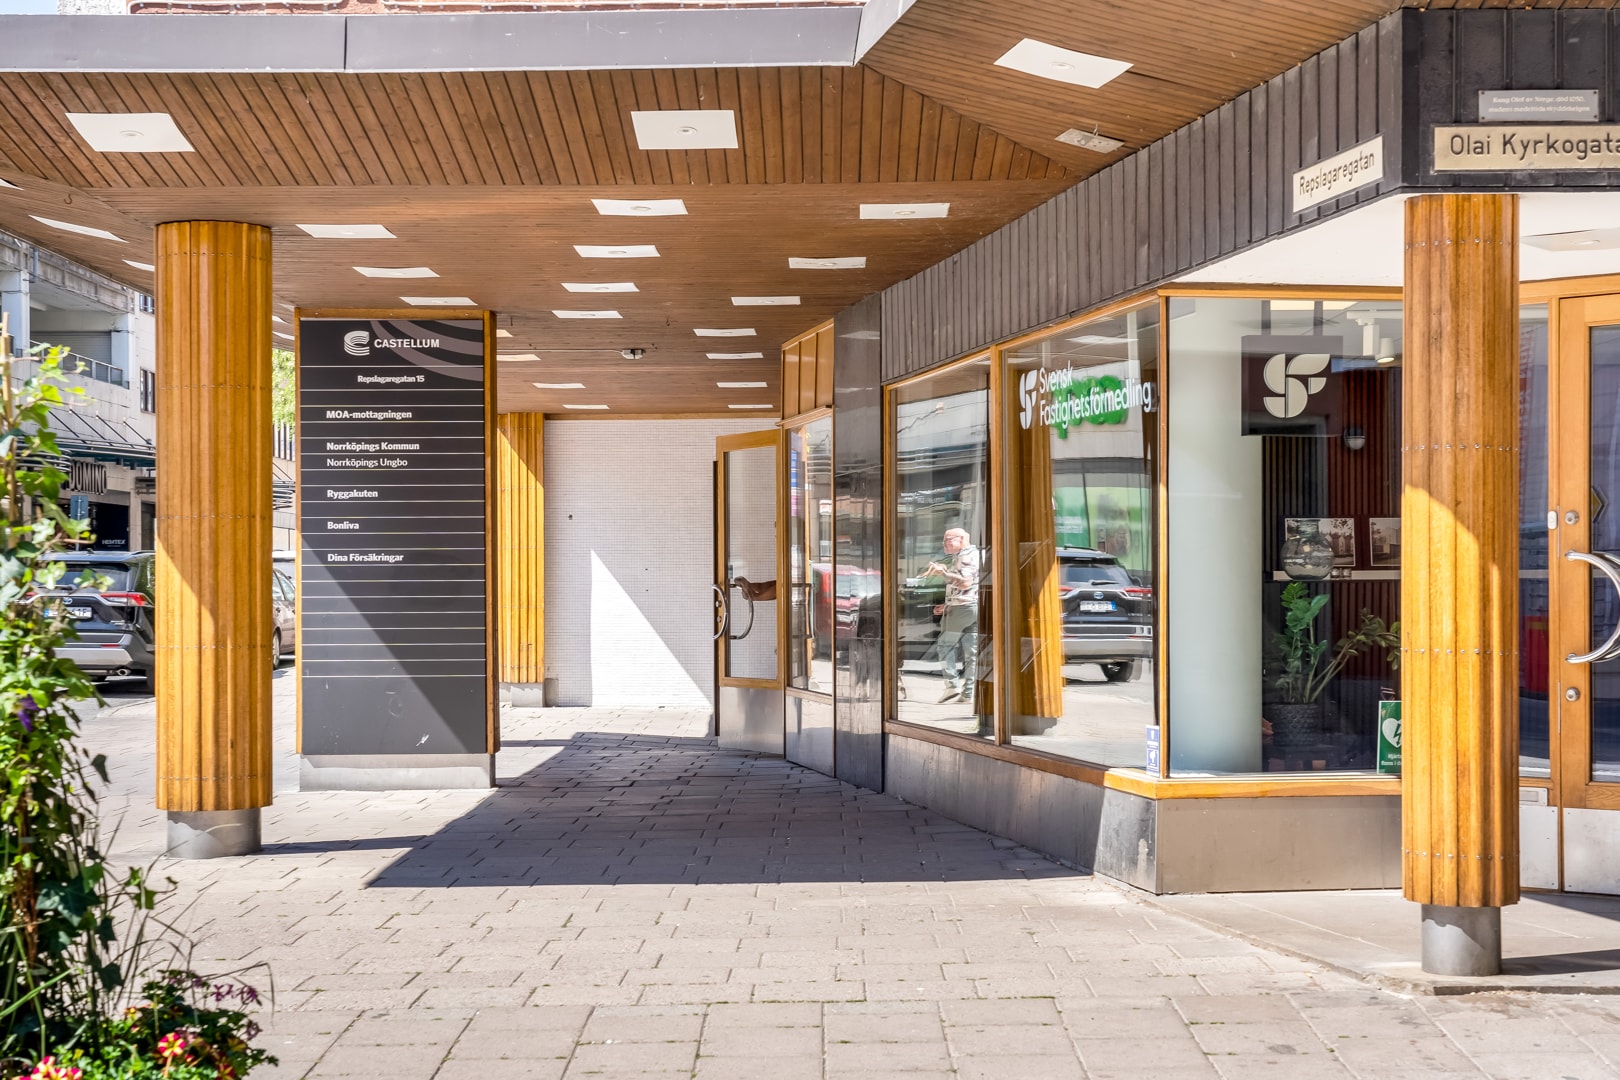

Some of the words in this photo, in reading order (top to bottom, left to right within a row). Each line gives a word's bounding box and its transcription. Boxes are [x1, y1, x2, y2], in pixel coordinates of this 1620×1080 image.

[1450, 134, 1491, 156] Olai
[1299, 150, 1375, 198] Repslagaregatan
[374, 338, 440, 348] CASTELLUM
[357, 375, 416, 384] Repslagaregatan
[416, 375, 425, 383] 15
[1039, 360, 1073, 394] Svensk
[1040, 378, 1152, 429] Fastighetsförmedling
[326, 410, 413, 420] MOA-mottagningen
[326, 442, 380, 452] Norrköpings
[381, 442, 420, 451] Kommun
[326, 458, 379, 468] Norrköpings
[380, 458, 408, 468] Ungbo
[68, 458, 107, 494] DOMINO
[327, 489, 379, 499] Ryggakuten
[327, 521, 360, 530] Bonliva
[327, 553, 348, 562] Dina
[349, 552, 404, 563] Försäkringar
